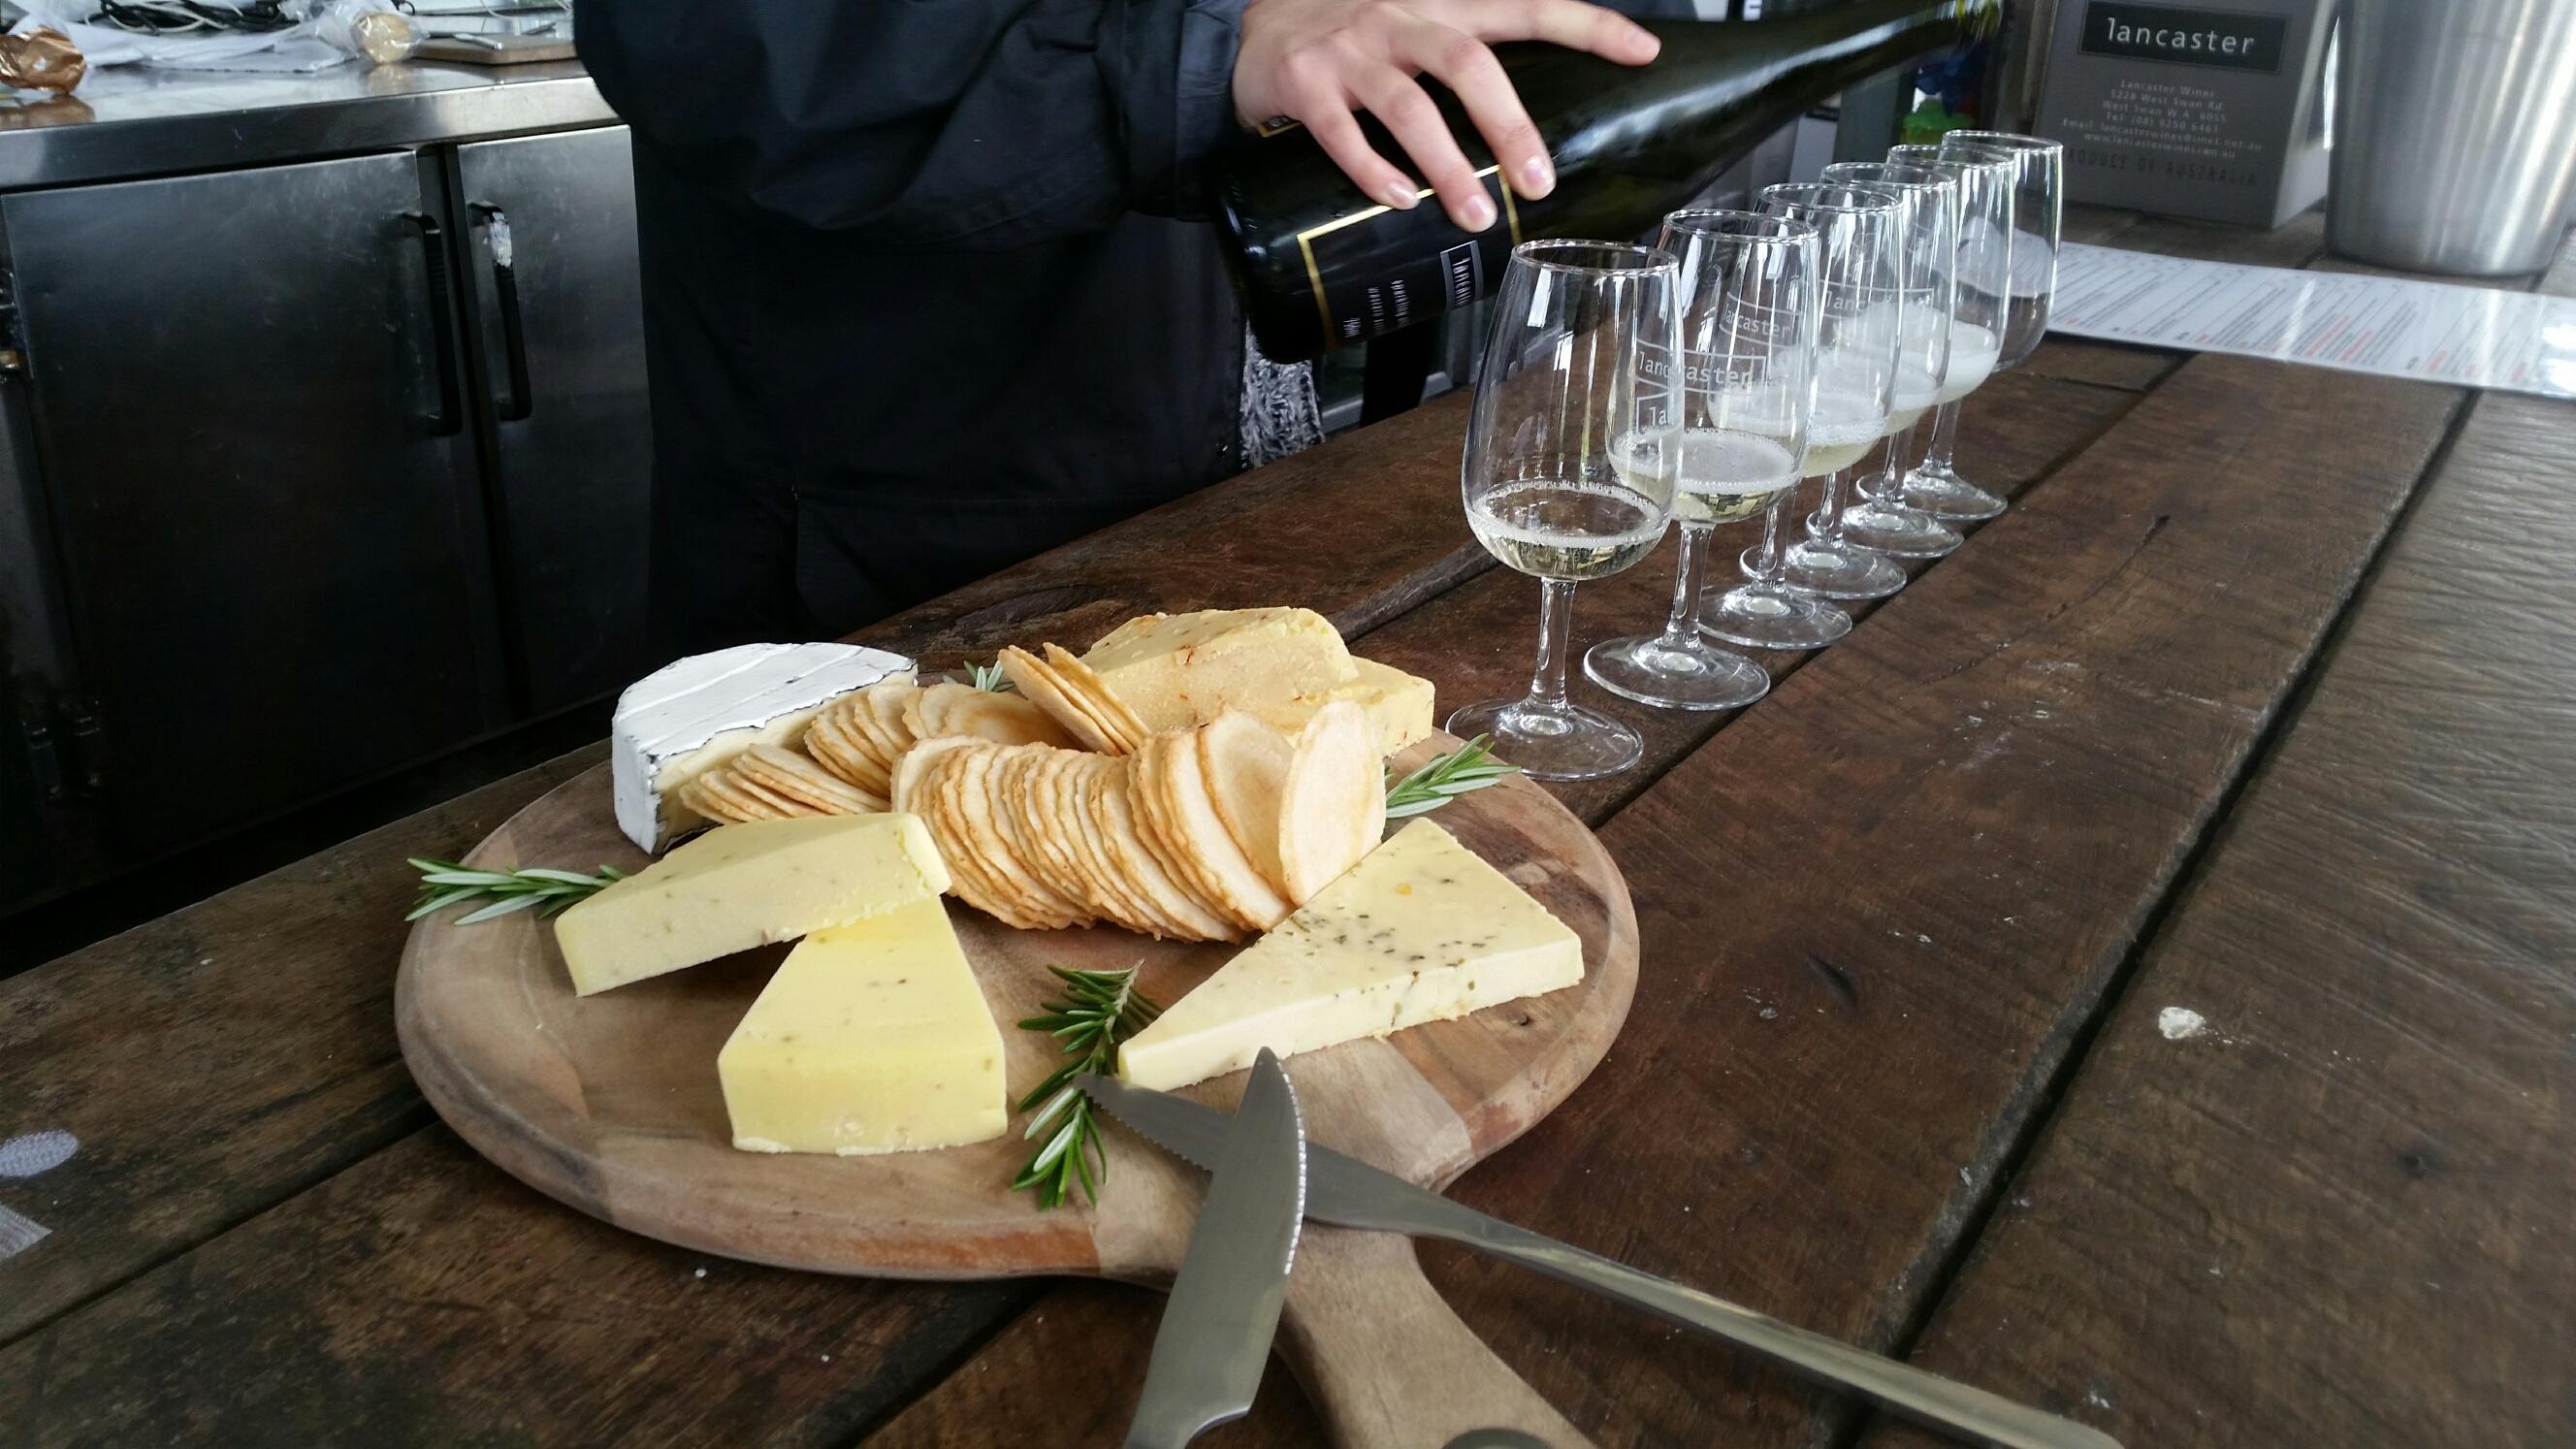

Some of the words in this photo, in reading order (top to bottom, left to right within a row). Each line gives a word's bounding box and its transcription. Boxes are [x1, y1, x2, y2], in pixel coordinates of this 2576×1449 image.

[2108, 16, 2254, 54] lancaster
[2120, 79, 2174, 94] Lancaster
[2181, 85, 2214, 99] Wines
[2141, 93, 2167, 105] West
[2174, 97, 2203, 109] Swan
[1723, 303, 1791, 339] lancaster
